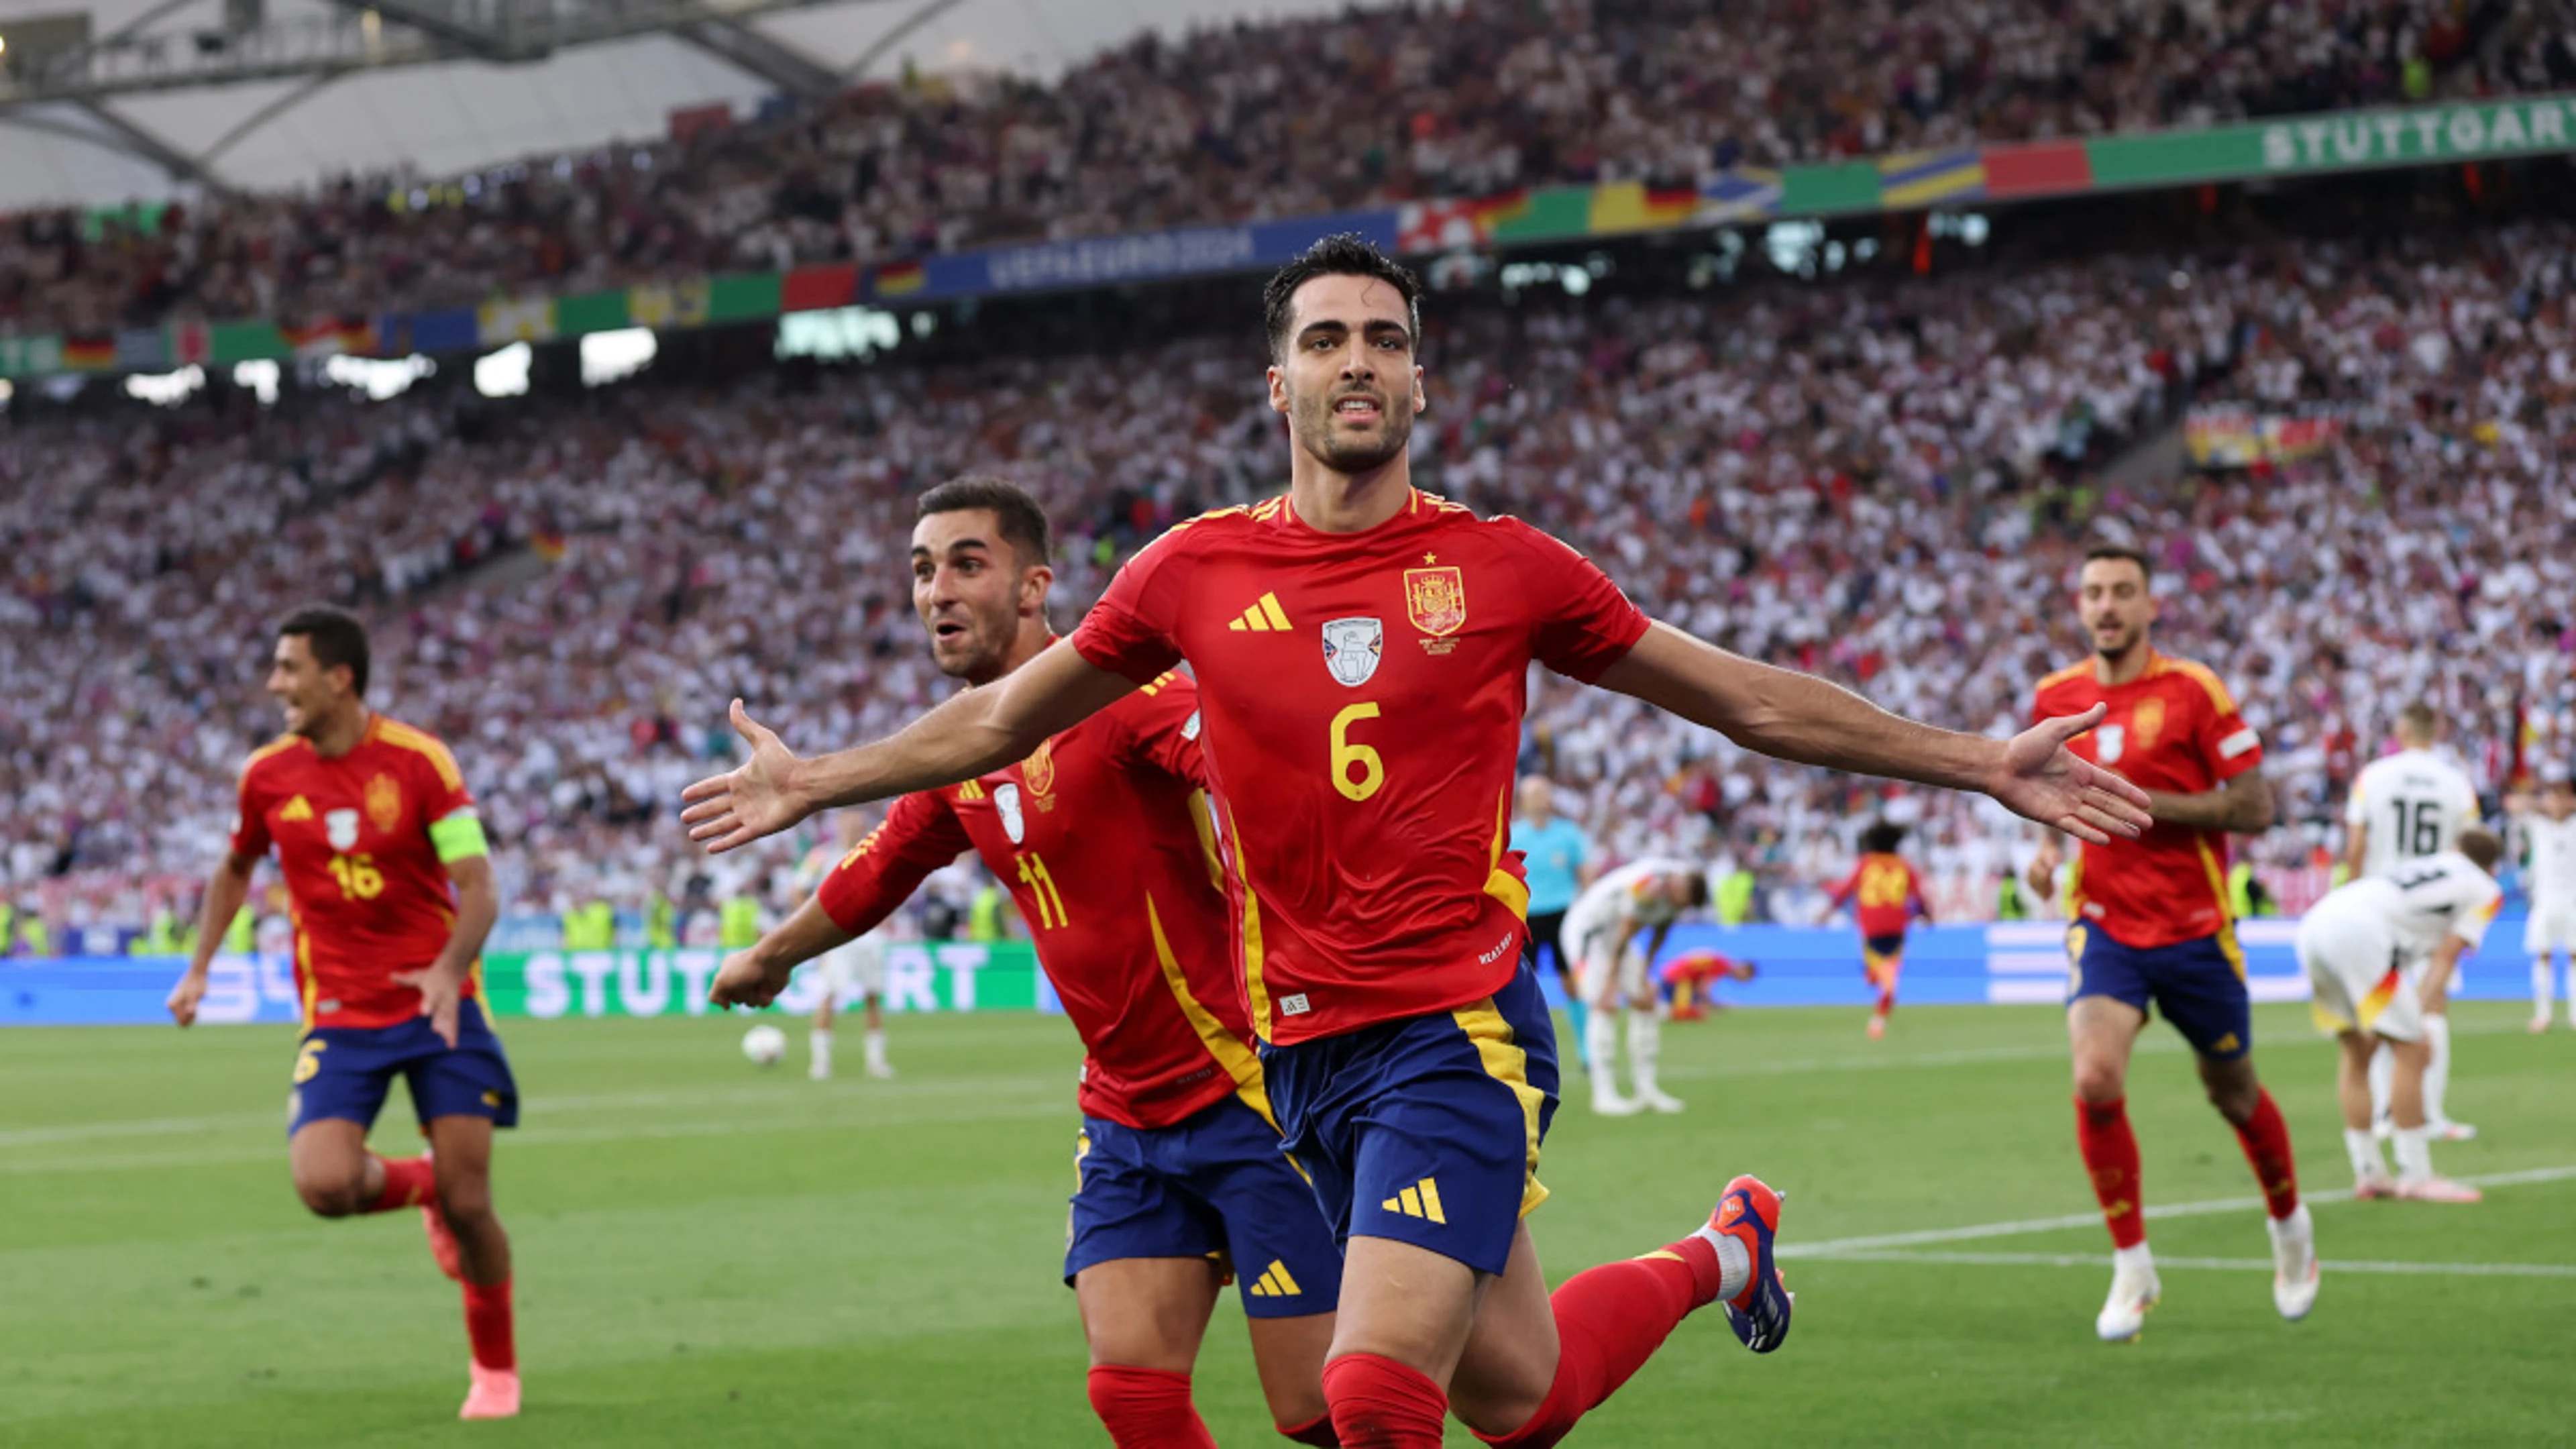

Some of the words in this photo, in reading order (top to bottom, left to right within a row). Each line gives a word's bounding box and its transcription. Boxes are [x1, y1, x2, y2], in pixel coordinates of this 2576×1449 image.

[2263, 96, 2576, 170] STUTTGAR
[1330, 701, 1385, 802] 6
[2391, 796, 2443, 857] 16
[327, 854, 384, 899] 16
[1016, 851, 1069, 930] 11
[523, 946, 990, 1017] STUTGRT
